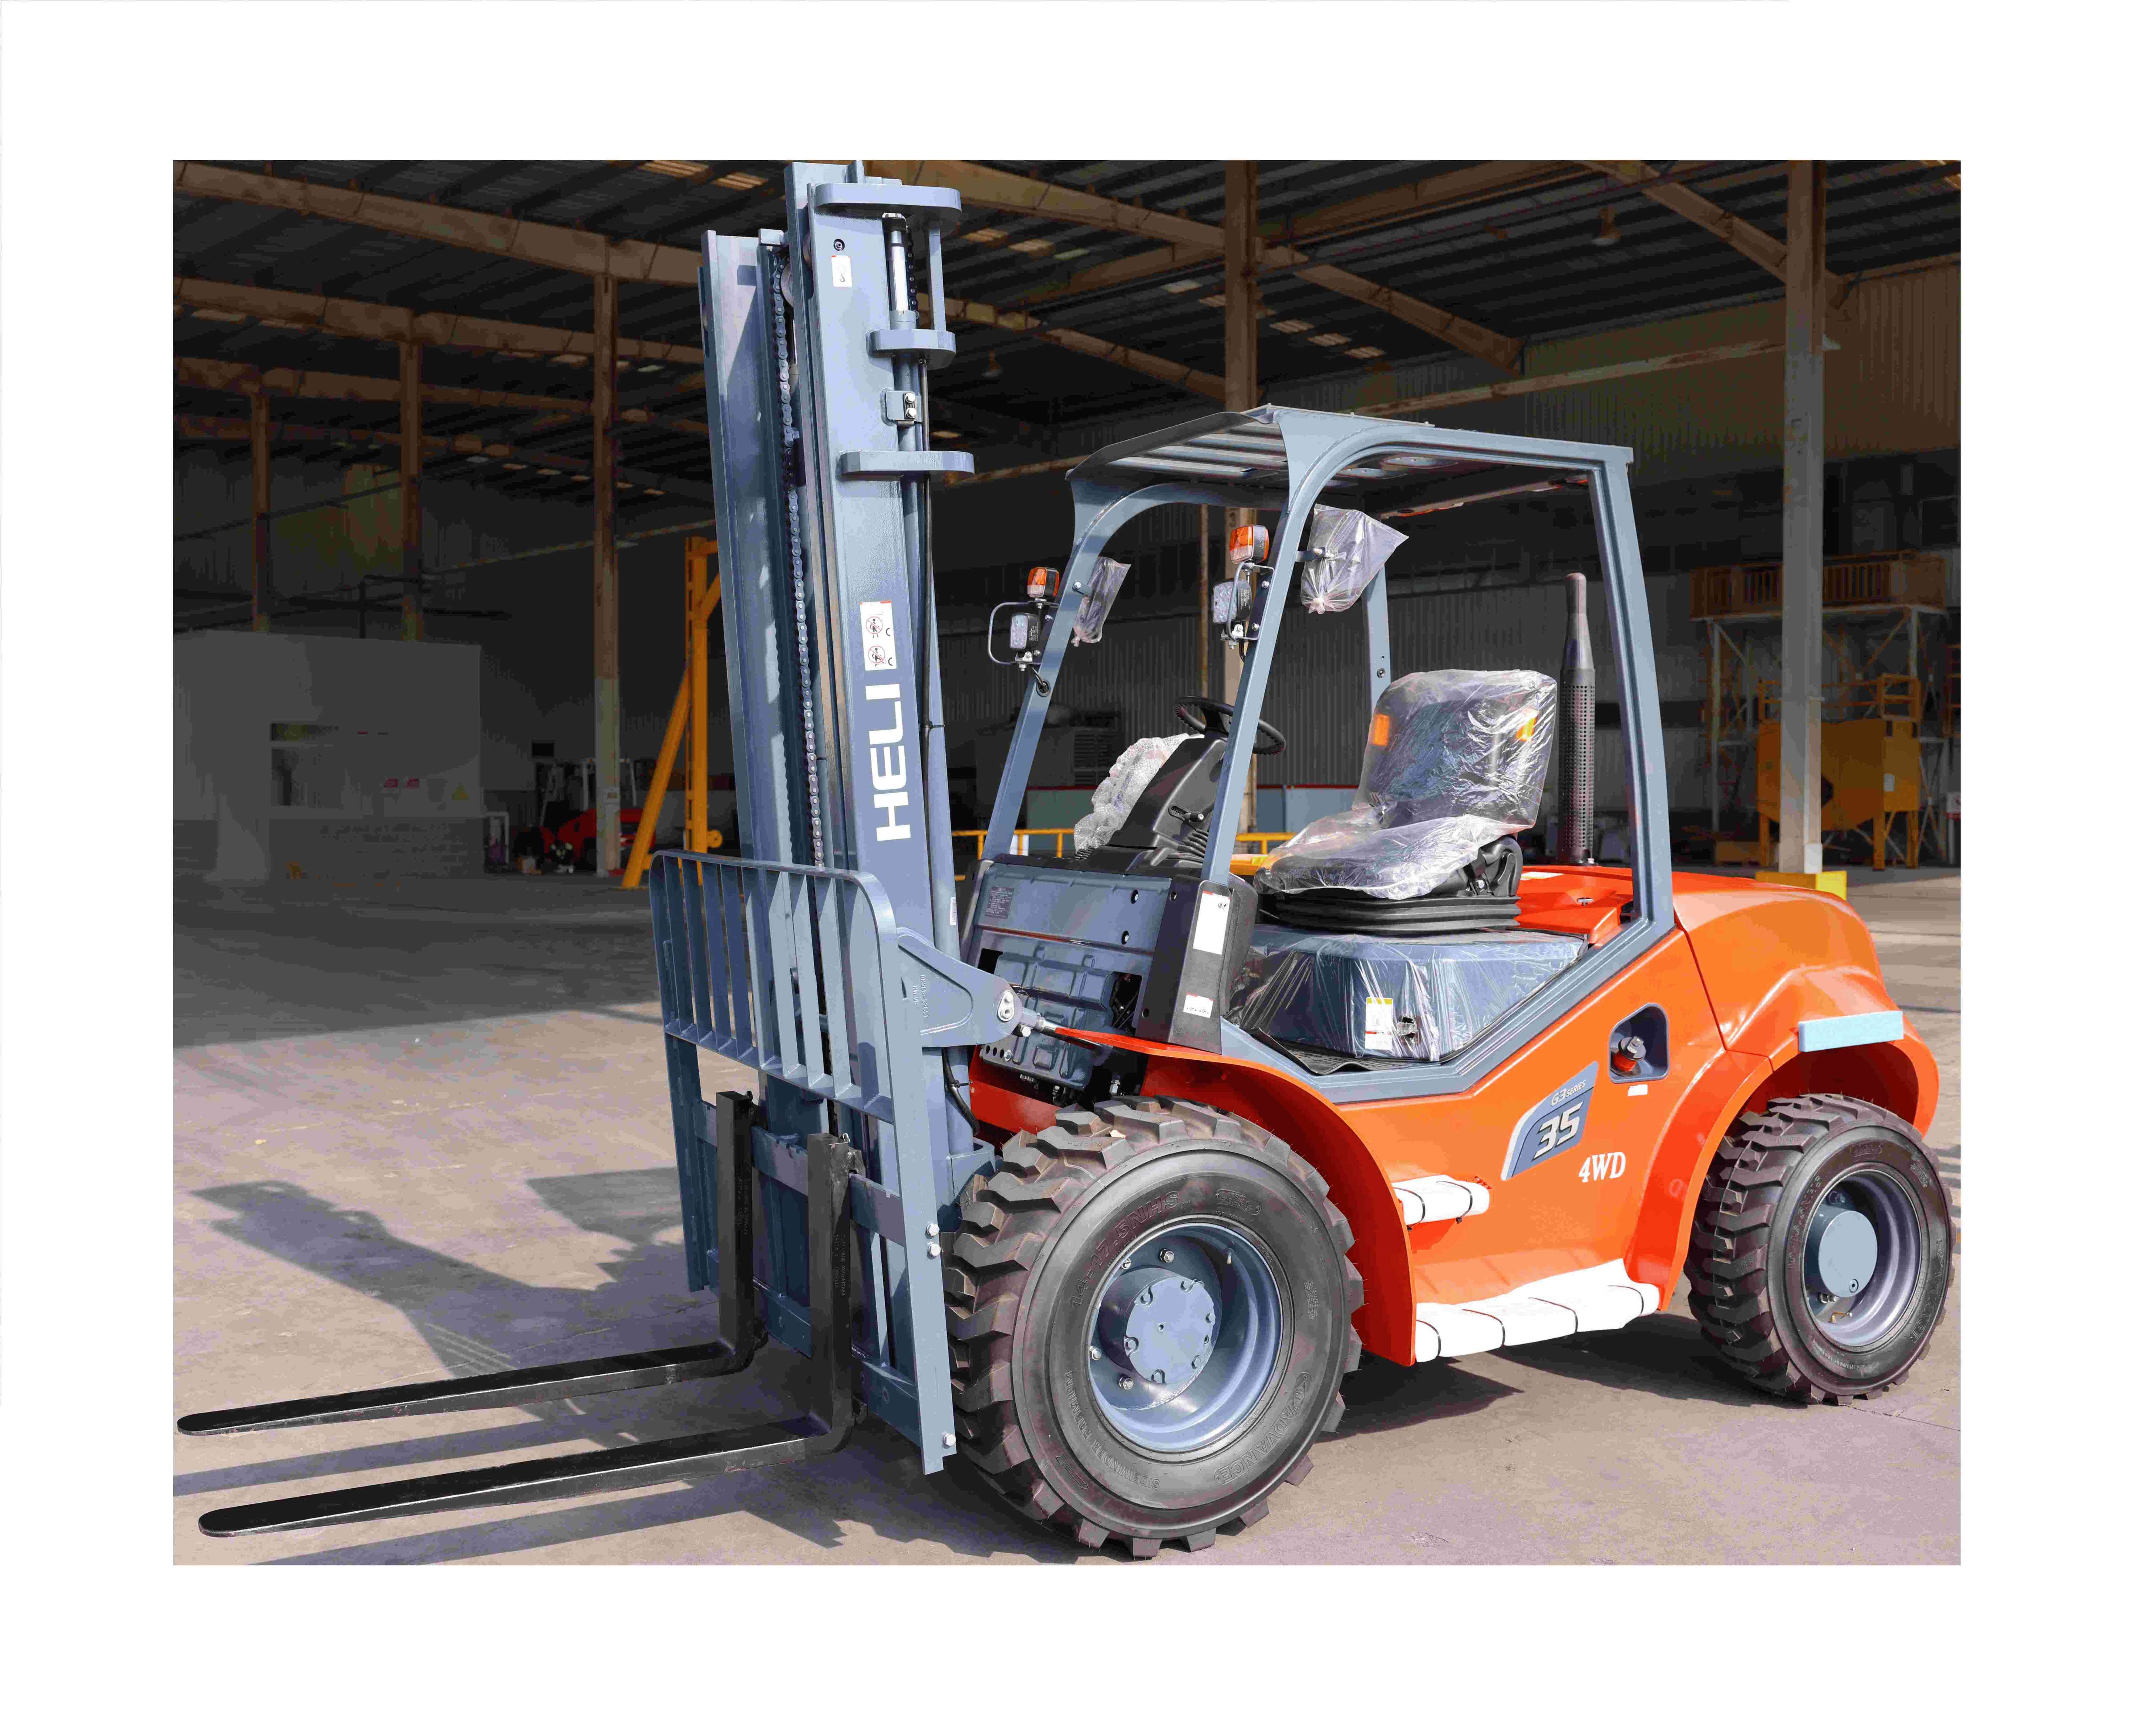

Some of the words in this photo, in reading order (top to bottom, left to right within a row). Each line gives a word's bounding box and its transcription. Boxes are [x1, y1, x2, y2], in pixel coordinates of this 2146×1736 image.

[865, 684, 911, 841] HELI
[1551, 1088, 1567, 1106] G3
[1565, 1079, 1586, 1098] SERIES
[1531, 1101, 1584, 1162] 35
[1579, 1152, 1625, 1182] 4WD
[1069, 1190, 1179, 1308] 14-17.5NHS
[1091, 1439, 1161, 1490] SIDEWINDER
[1219, 1404, 1297, 1484] ADVANCE
